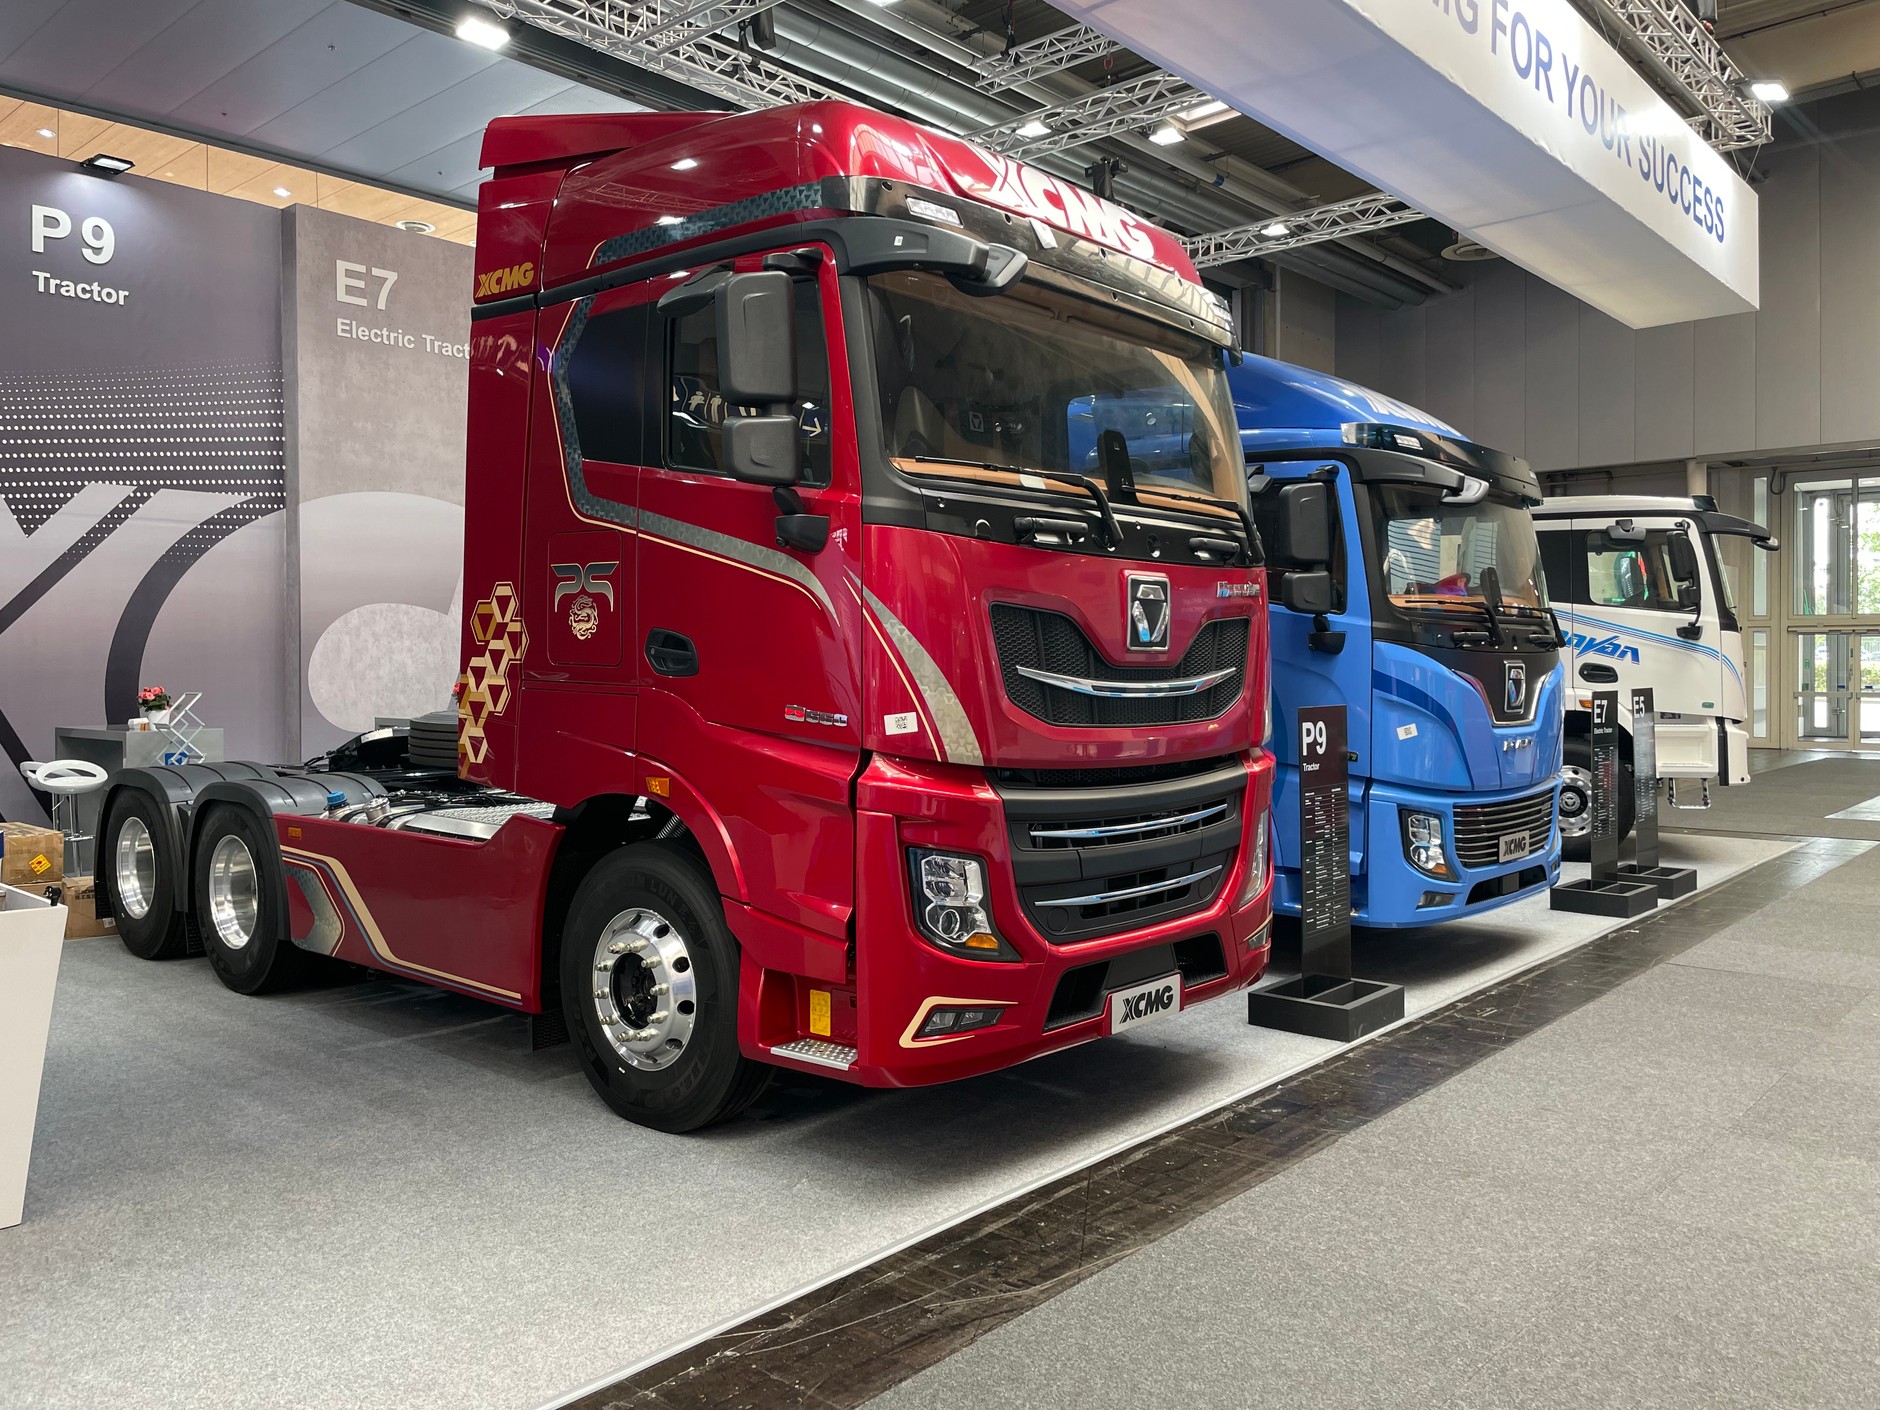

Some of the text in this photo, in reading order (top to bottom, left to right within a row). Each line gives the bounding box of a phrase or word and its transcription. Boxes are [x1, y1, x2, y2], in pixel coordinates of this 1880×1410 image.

[1491, 0, 1554, 103] FOR
[1561, 52, 1631, 168] YOUR
[1638, 133, 1725, 244] SUCCESS
[962, 141, 1155, 259] XCMG
[31, 204, 115, 265] P9
[32, 271, 129, 306] Tractor
[335, 259, 399, 311] E7
[475, 262, 535, 298] XCMG
[336, 319, 415, 350] Electric
[1593, 700, 1608, 724] E7
[1633, 696, 1645, 719] E5
[1302, 720, 1327, 756] P9
[1302, 763, 1320, 772] Tractor
[1503, 838, 1526, 856] XCMG
[1119, 985, 1174, 1024] XCMG
